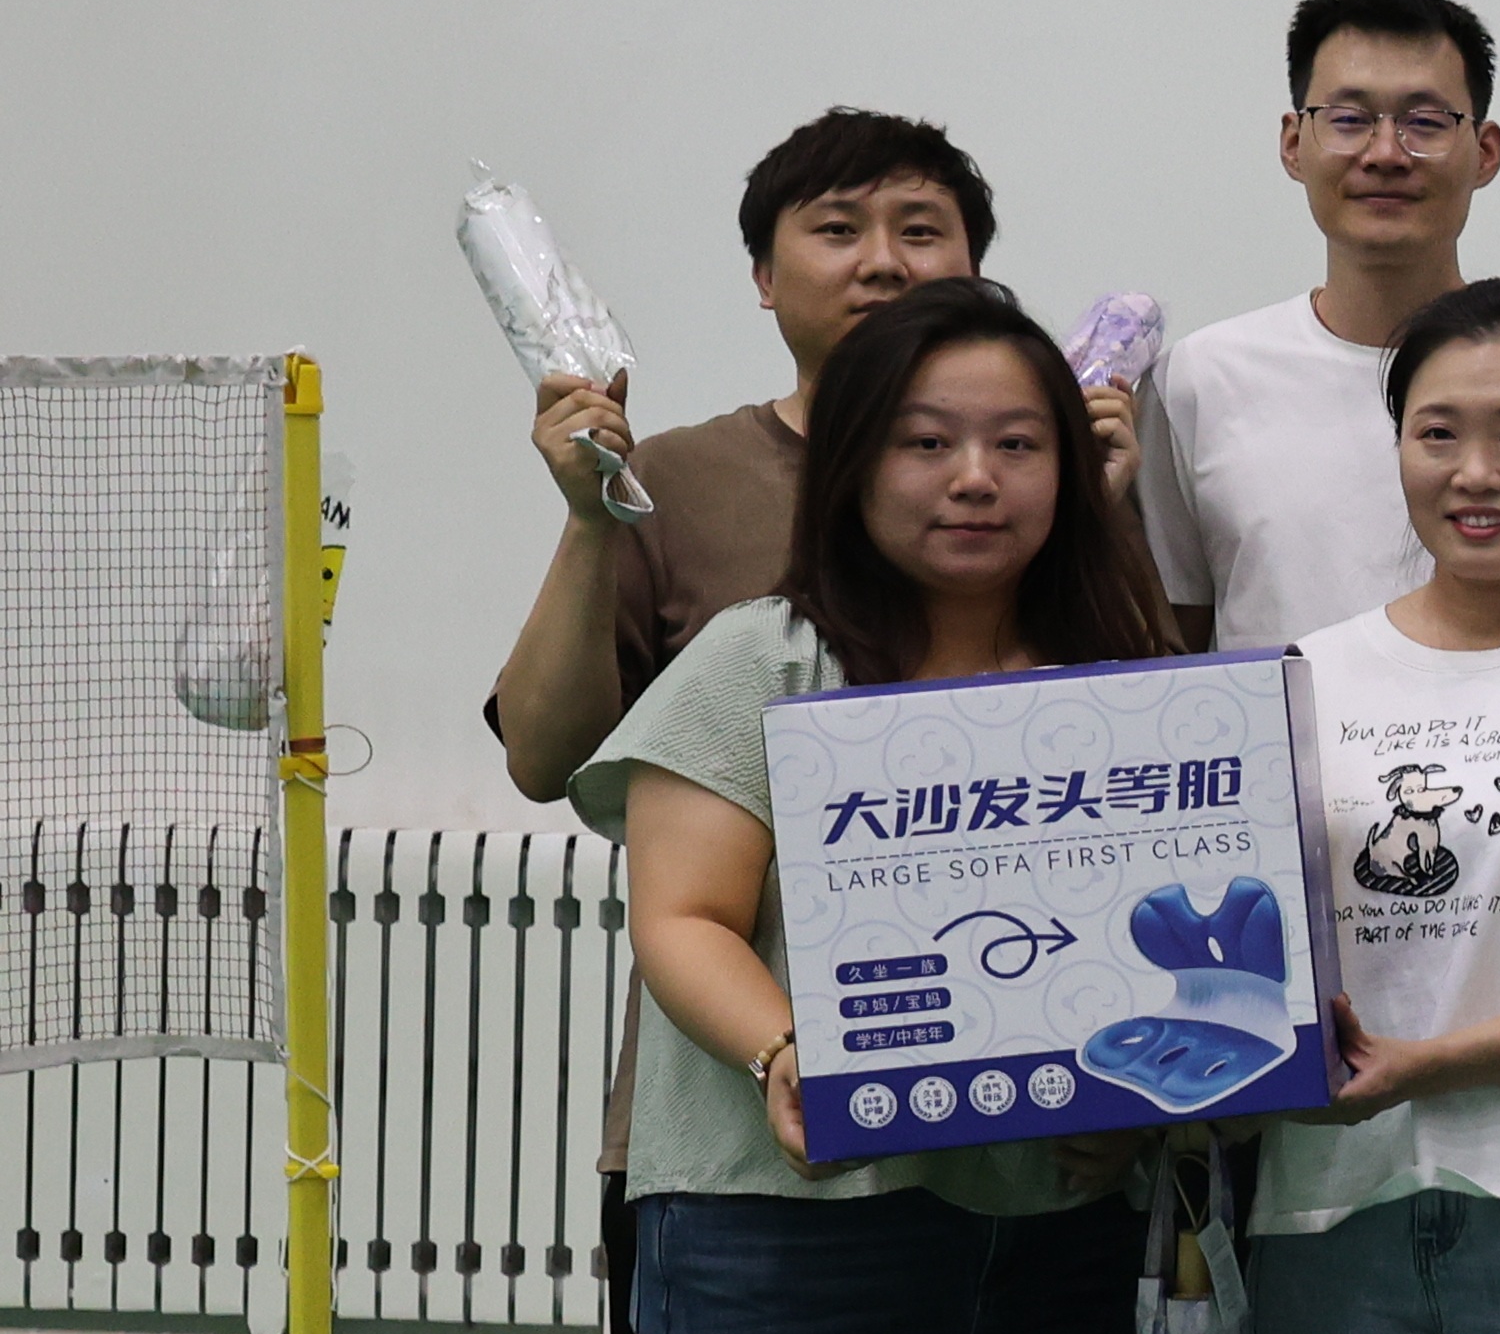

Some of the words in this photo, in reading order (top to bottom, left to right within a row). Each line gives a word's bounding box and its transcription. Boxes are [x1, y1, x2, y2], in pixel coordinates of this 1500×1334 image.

[1385, 723, 1421, 738] CAN
[1429, 720, 1457, 732] DO
[1466, 715, 1486, 731] IT
[1374, 737, 1416, 756] LIKE
[1459, 734, 1469, 745] A
[825, 755, 1243, 845] 大沙发头等舱
[828, 861, 933, 892] LARGE
[950, 852, 1032, 881] SOFA
[1049, 842, 1136, 870] FIRST
[1153, 831, 1252, 859] CLASS
[1391, 901, 1419, 915] CAN
[1424, 899, 1446, 912] DO
[1451, 898, 1460, 915] IT
[1420, 922, 1446, 938] THE
[849, 958, 937, 982] 久坐一族
[852, 992, 942, 1016] 孕妈/宝妈
[856, 1026, 944, 1049] 学生/中老年
